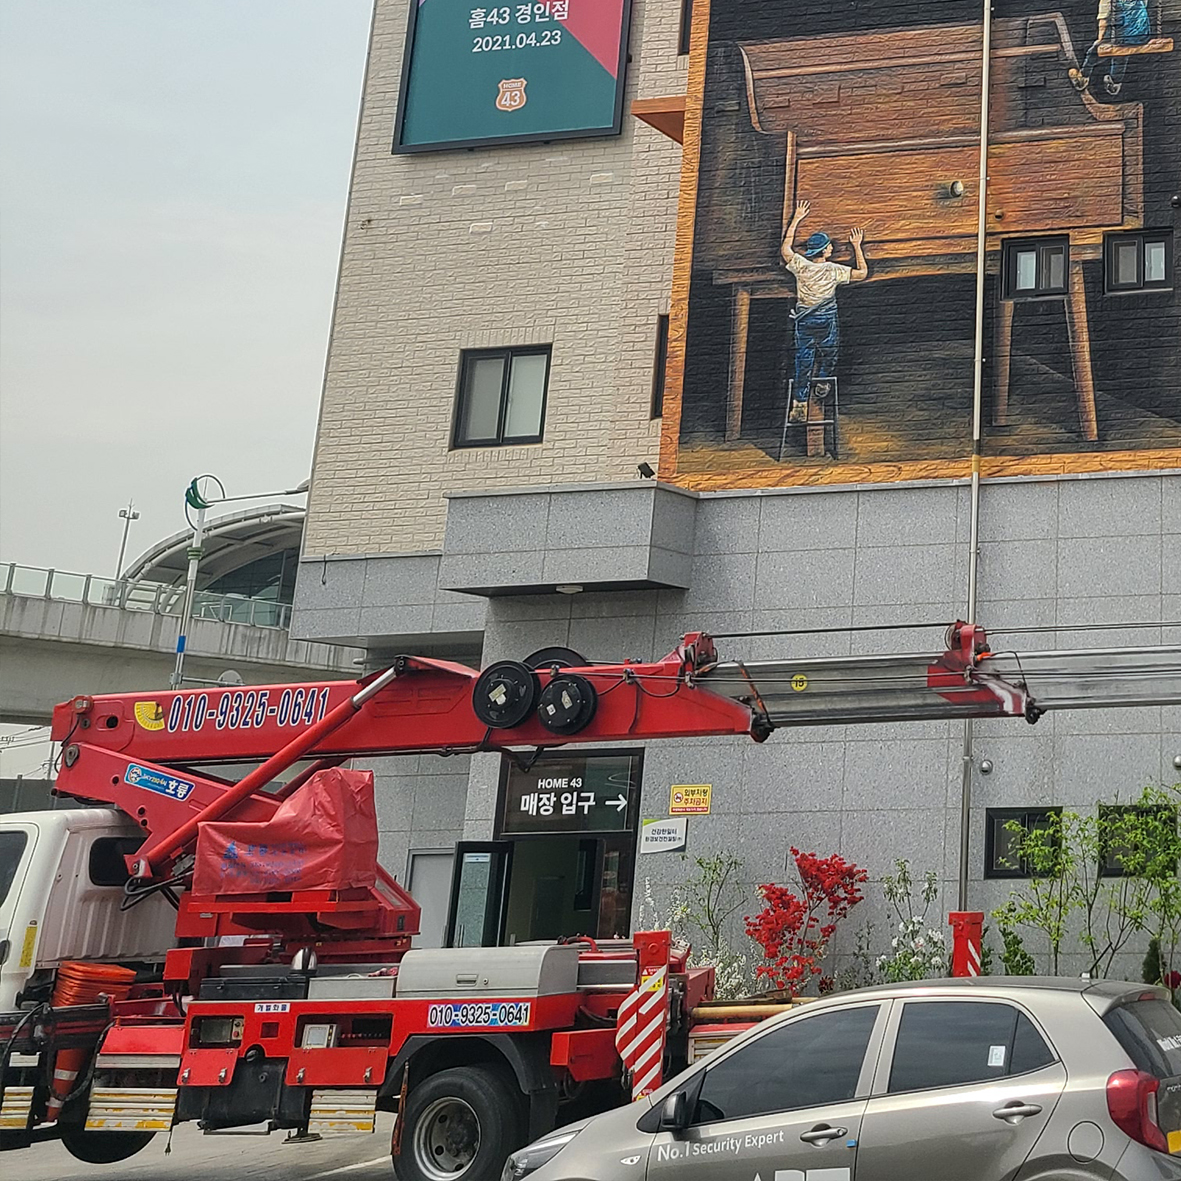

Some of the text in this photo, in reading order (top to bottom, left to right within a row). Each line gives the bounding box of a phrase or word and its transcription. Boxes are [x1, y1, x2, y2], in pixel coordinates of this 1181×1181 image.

[469, 0, 570, 29] 홈43 경인점
[472, 30, 562, 53] 2021.04.23
[501, 91, 521, 107] 43
[167, 687, 330, 733] 010-9325-0641
[537, 777, 582, 789] HOME 43
[520, 791, 595, 816] 매장 입구
[428, 1003, 530, 1027] 010-9325-0641
[657, 1130, 784, 1162] No.1 Security Expert
